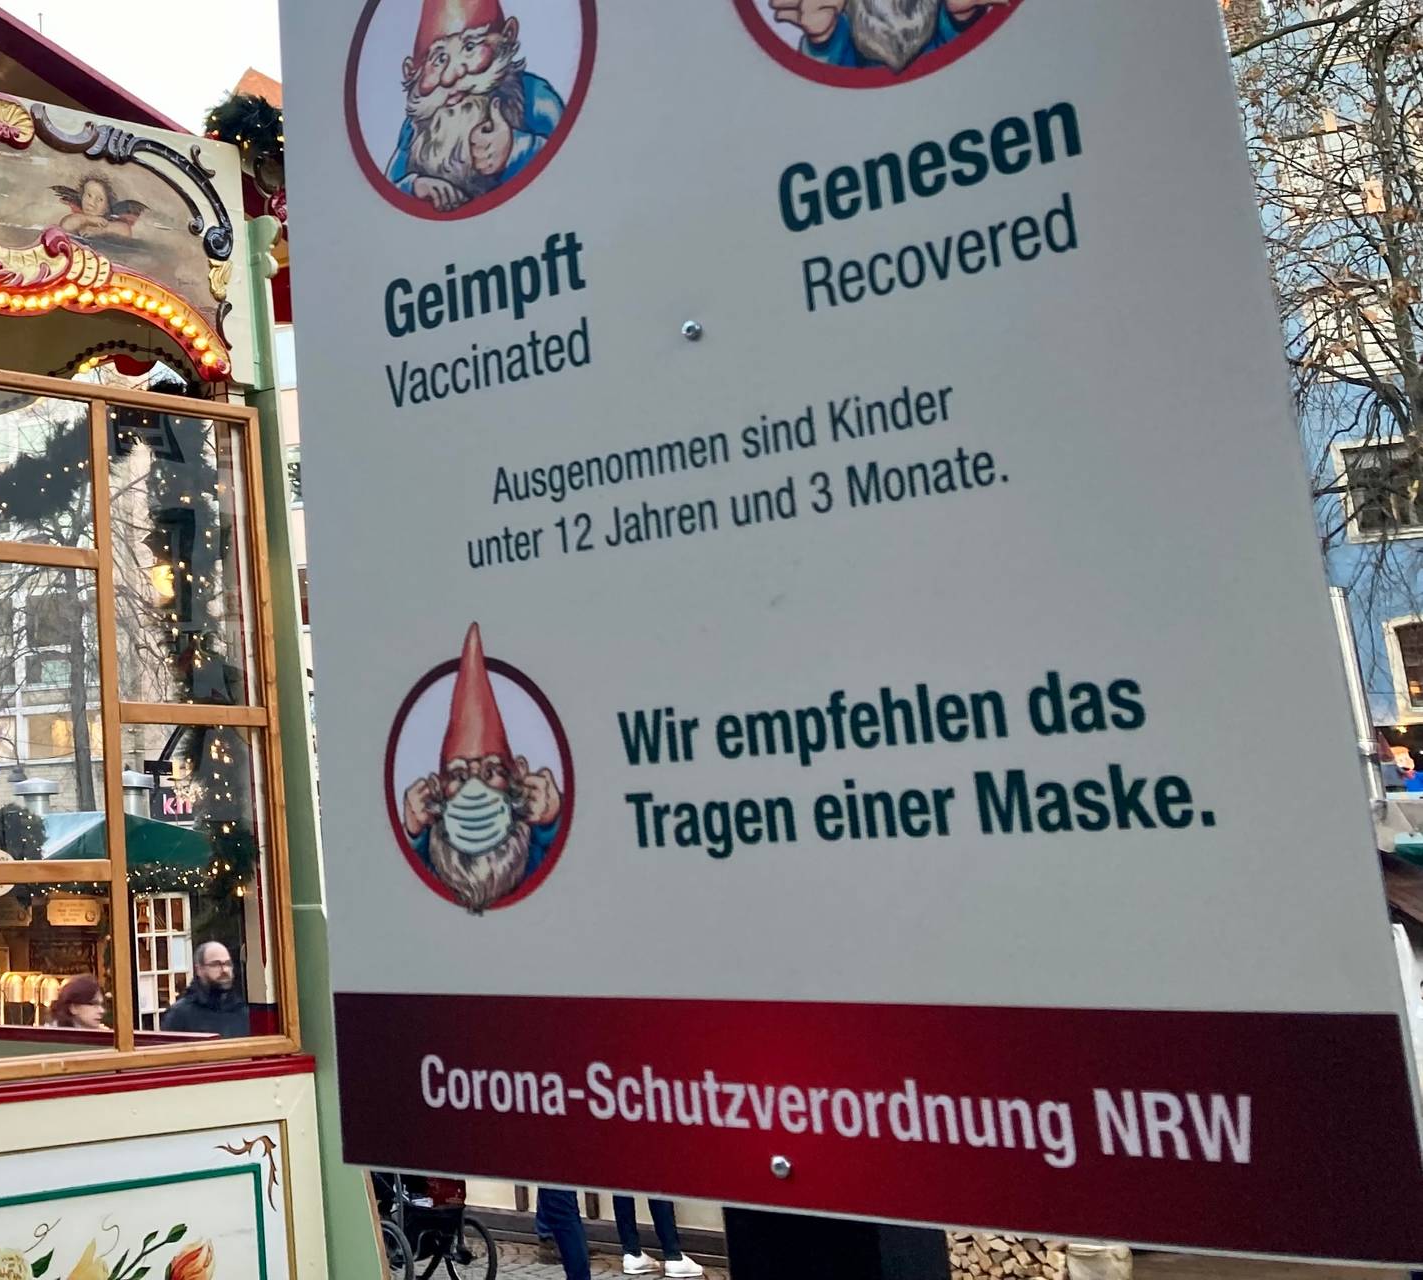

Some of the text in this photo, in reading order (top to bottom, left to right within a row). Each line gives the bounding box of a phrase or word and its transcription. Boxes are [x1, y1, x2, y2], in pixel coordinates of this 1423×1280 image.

[777, 100, 1083, 233] Genesen
[383, 231, 587, 340] Geimpft
[801, 196, 1079, 313] Recovered
[384, 315, 592, 409] Vaccinated
[492, 385, 954, 506] Ausgenommen sind Kinder
[467, 446, 1009, 570] unter 12 Jahren und 3 Monate.
[616, 669, 1147, 768] Wir empfehlen das
[624, 762, 1217, 860] Tragen einer Maske.
[421, 1054, 1252, 1169] Corona-Schutzverordnung NRW
